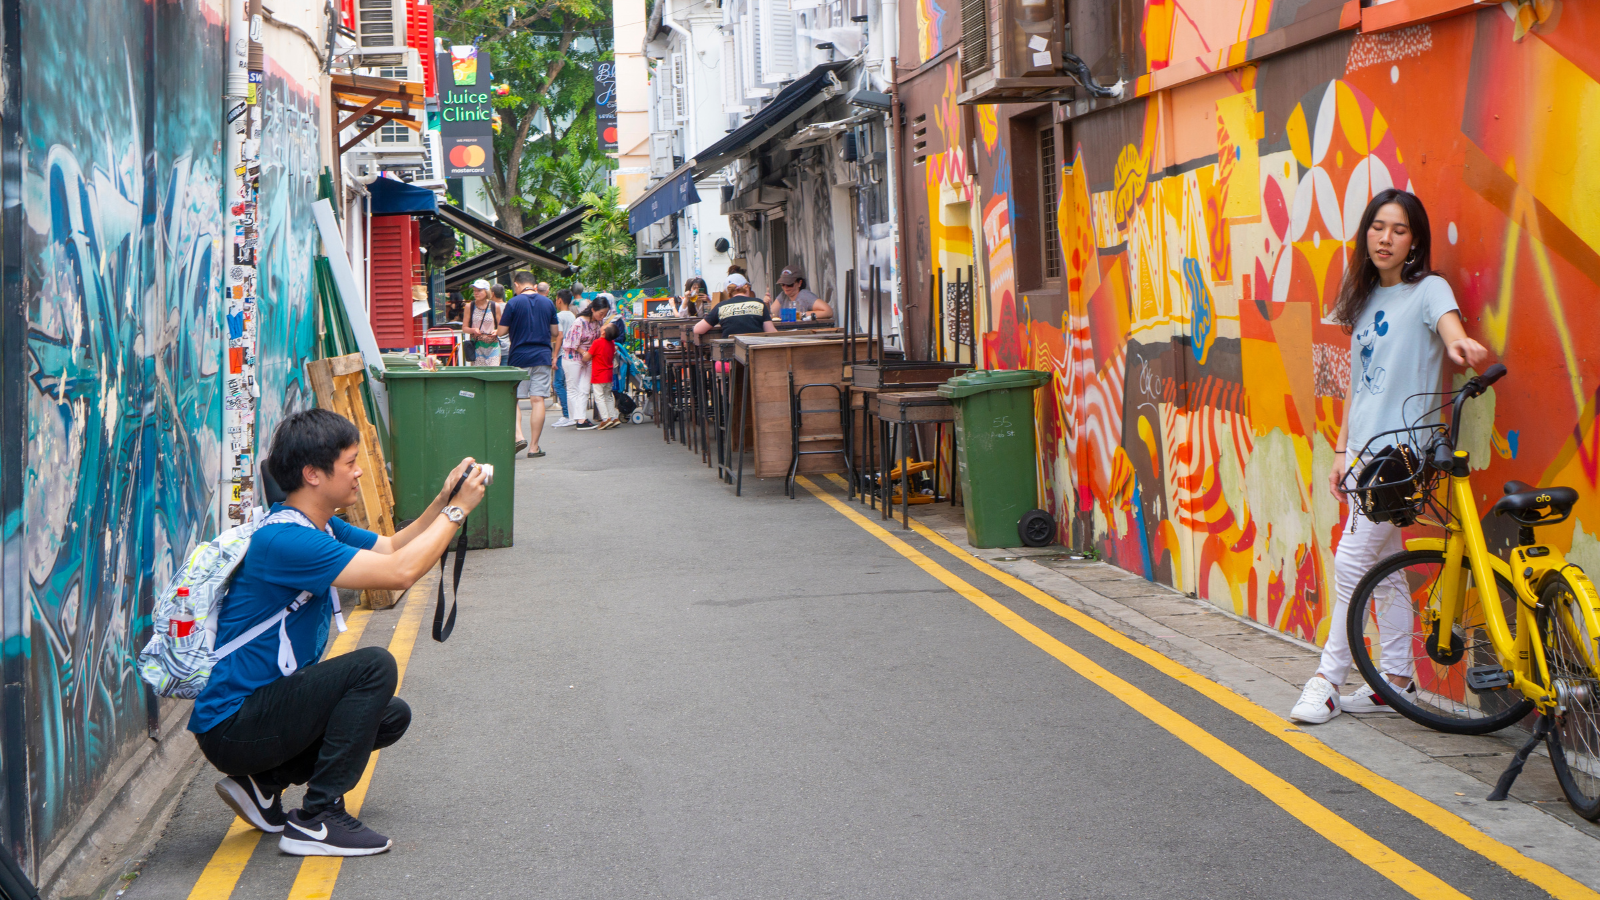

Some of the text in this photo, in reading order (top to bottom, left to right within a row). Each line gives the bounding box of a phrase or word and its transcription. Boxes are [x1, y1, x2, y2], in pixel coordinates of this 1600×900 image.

[443, 89, 488, 104] Juice
[442, 106, 490, 121] Clinic
[1535, 493, 1551, 503] ofo
